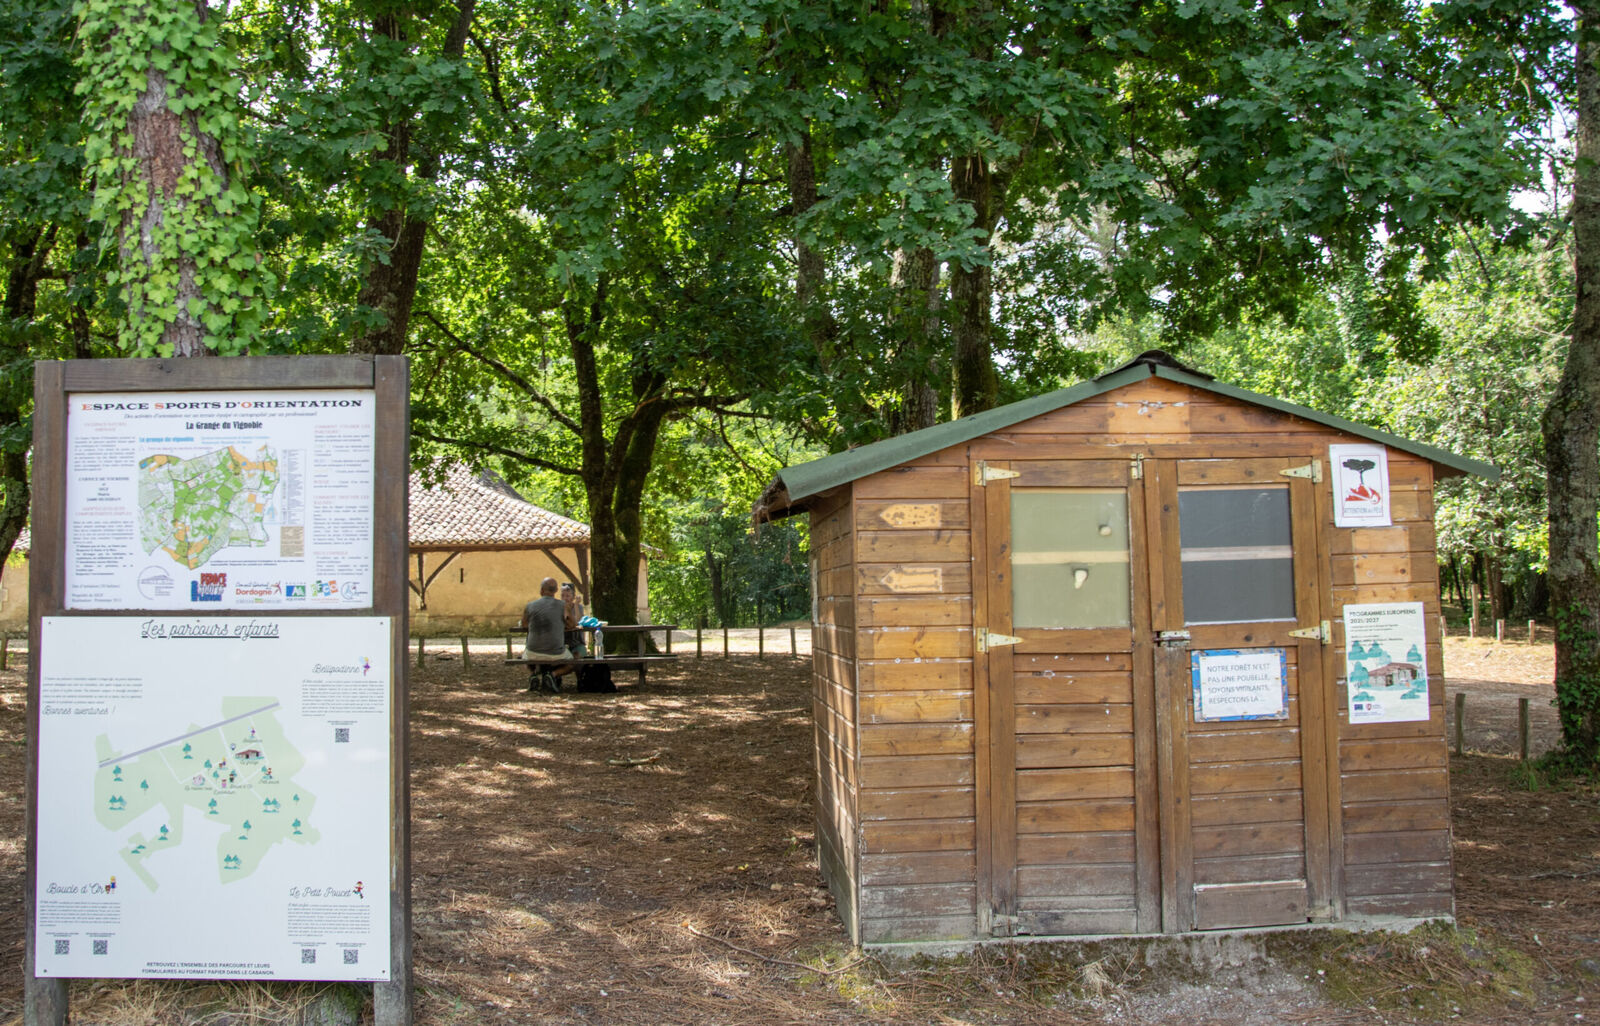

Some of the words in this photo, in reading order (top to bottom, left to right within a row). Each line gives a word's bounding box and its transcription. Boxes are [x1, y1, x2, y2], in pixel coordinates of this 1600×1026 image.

[81, 402, 150, 411] ESPACE
[154, 401, 222, 410] SPORTS
[225, 399, 363, 409] D'ORIENTATION
[186, 421, 194, 430] La
[196, 421, 220, 431] Grange
[222, 421, 231, 430] du
[233, 420, 263, 431] Vignoble
[235, 588, 273, 597] Dordogne
[141, 619, 166, 639] Les
[168, 623, 228, 640] parcours
[234, 619, 279, 641] enfants
[1207, 664, 1230, 673] NOTRE
[1230, 663, 1252, 672] FORÊT
[1252, 662, 1271, 671] N'EST
[1207, 675, 1221, 683] PAS
[1208, 686, 1235, 694] SOYONS
[1208, 696, 1250, 705] RESPECTONS
[42, 704, 72, 715] Bonnes
[74, 706, 109, 715] aventures
[46, 882, 78, 895] Boucle
[289, 886, 301, 899] Le
[302, 886, 322, 898] Petit
[324, 886, 351, 898] Poucet
